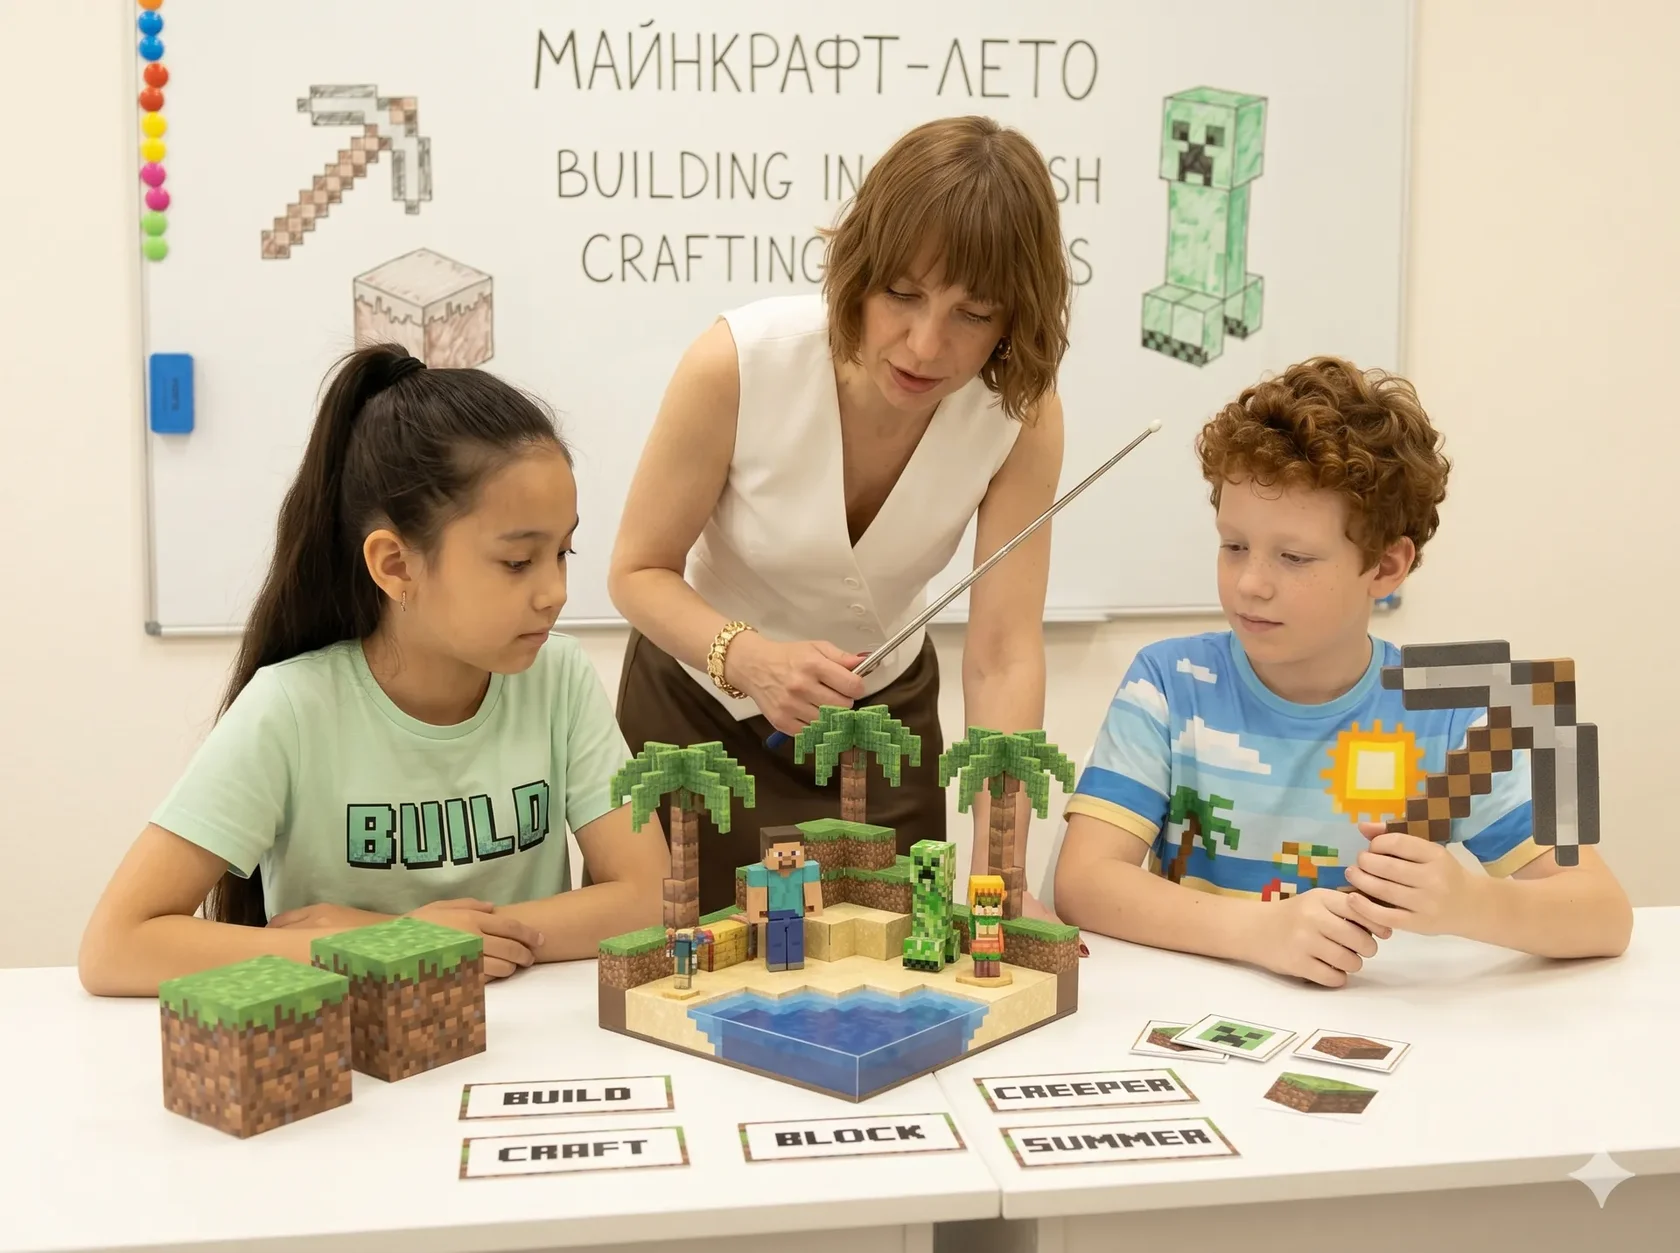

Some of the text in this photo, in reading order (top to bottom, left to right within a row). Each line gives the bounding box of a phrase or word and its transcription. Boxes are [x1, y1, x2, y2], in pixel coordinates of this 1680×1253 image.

[534, 19, 1098, 101] МАЙНКРАФТ-ЛЕТО
[557, 149, 863, 201] BUILDING IN
[581, 232, 828, 284] CRAFTING
[347, 780, 549, 870] BUILD
[503, 1087, 631, 1106] BUILD
[993, 1078, 1175, 1100] CREEPER
[775, 1125, 926, 1147] BLOCK
[1022, 1129, 1211, 1153] SUMMER
[498, 1139, 648, 1162] CRAFT
